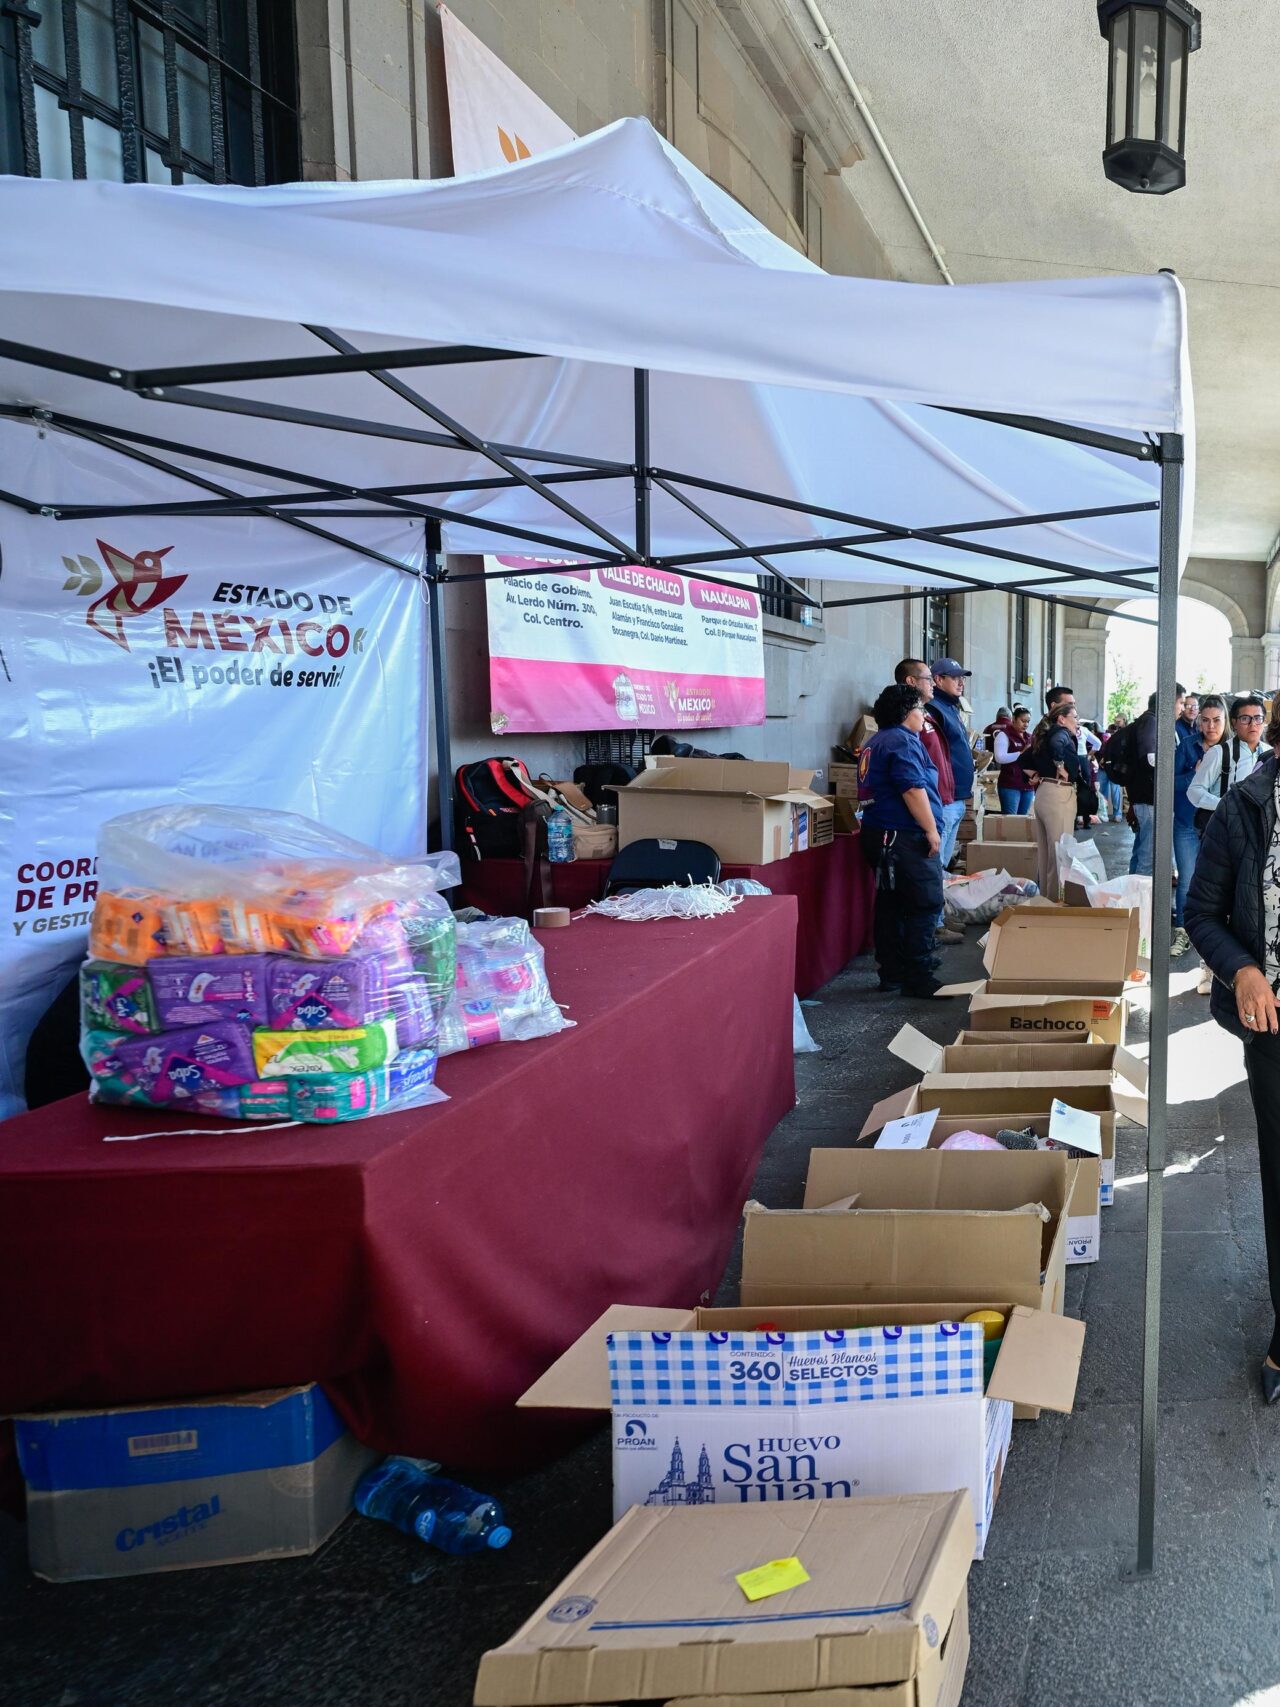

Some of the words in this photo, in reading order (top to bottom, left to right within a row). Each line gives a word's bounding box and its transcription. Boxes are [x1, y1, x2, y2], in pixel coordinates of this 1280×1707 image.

[504, 575, 533, 590] Palacio
[535, 580, 549, 592] de
[602, 567, 632, 586] VALLE
[632, 571, 645, 589] DE
[645, 577, 681, 597] CHALCO
[212, 582, 314, 612] ESTADO
[318, 594, 354, 616] DE
[517, 594, 545, 608] Lerdo
[547, 598, 580, 612] Núm.
[700, 588, 751, 610] NAUCALPAN
[523, 612, 541, 624] Col.
[543, 614, 584, 629] Centro.
[163, 607, 350, 658] MÉXICO
[148, 655, 184, 689] ¡El
[192, 659, 263, 690] poder
[270, 661, 292, 687] de
[296, 664, 345, 688] servir!
[17, 856, 98, 884] COOR
[15, 886, 56, 913] DE
[63, 880, 98, 906] PR
[13, 921, 28, 937] Y
[297, 1004, 330, 1020] Saba
[1010, 1016, 1086, 1031] Bachoco
[167, 1064, 202, 1081] Saba
[1067, 1238, 1093, 1246] PROAN
[788, 1353, 828, 1367] Huevos
[831, 1351, 878, 1365] Blancos
[729, 1361, 781, 1382] 360
[789, 1364, 879, 1381] SELECTOS
[617, 1437, 656, 1446] PROAN
[723, 1442, 820, 1484] San
[115, 1495, 221, 1553] Cristal
